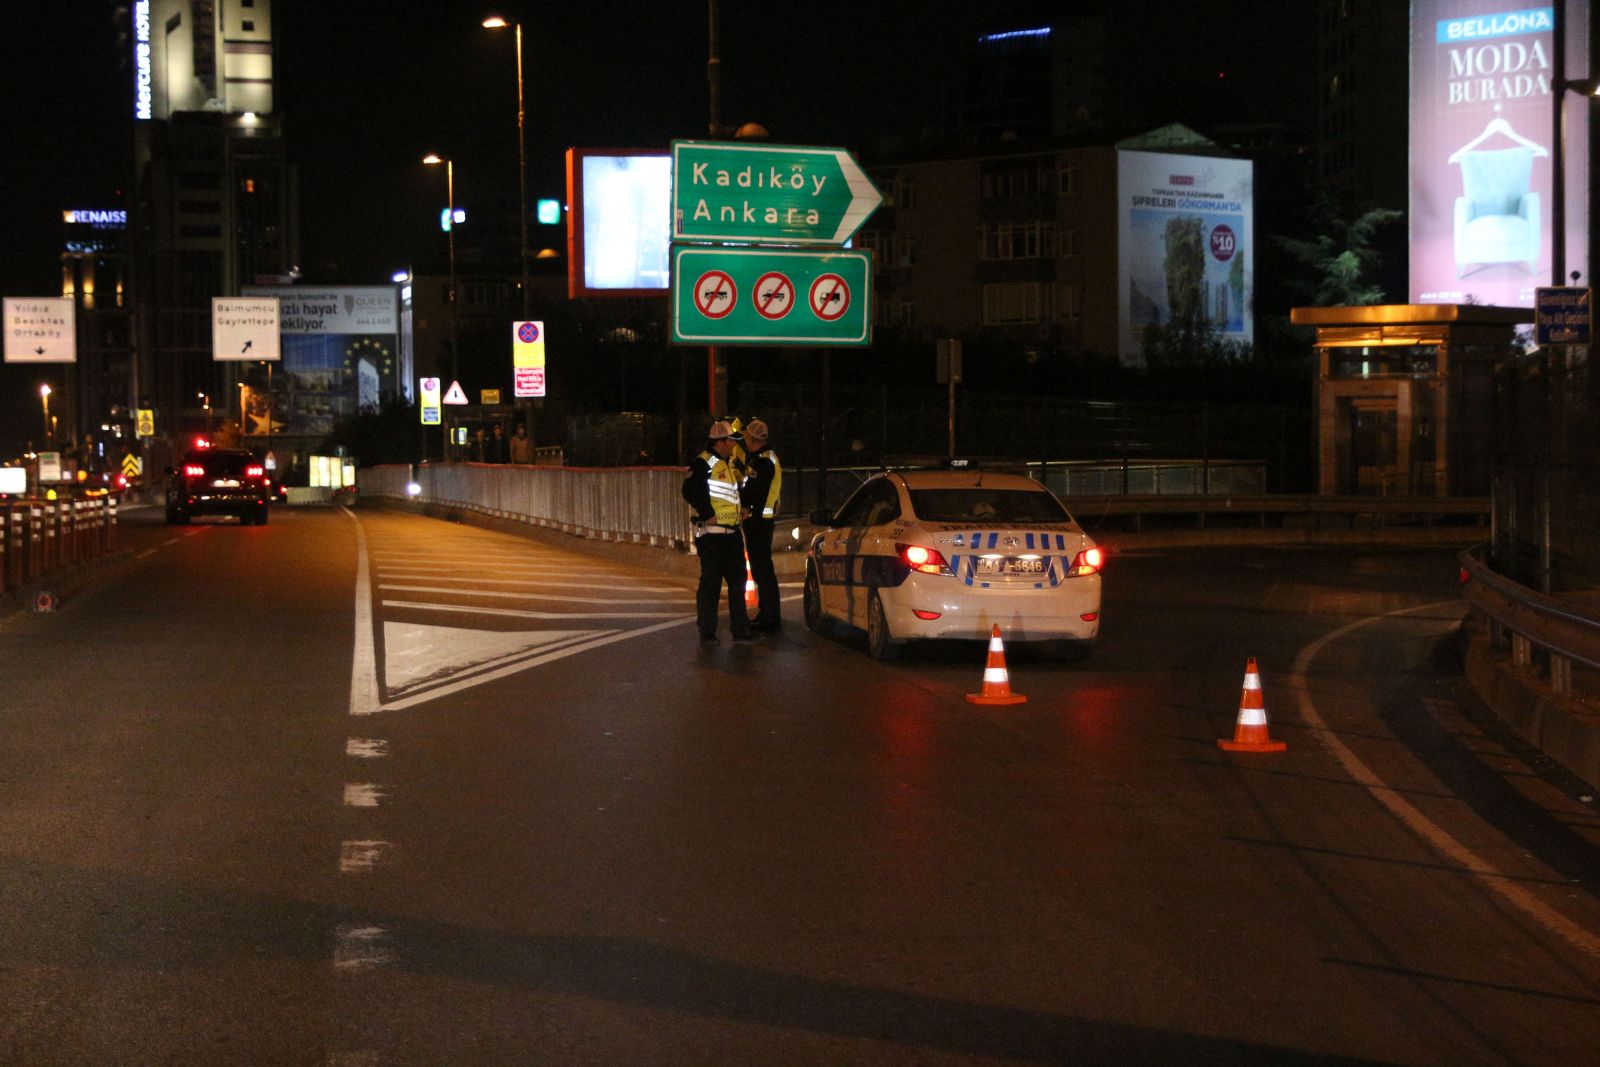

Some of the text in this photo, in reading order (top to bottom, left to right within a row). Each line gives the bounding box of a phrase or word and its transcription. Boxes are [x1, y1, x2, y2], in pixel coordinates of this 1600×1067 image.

[1447, 11, 1551, 39] BELLONA
[1448, 40, 1549, 79] MODA
[1448, 73, 1549, 105] BURADA
[692, 162, 827, 196] Kadıköy
[693, 198, 819, 225] Ankara
[302, 303, 338, 317] hayat
